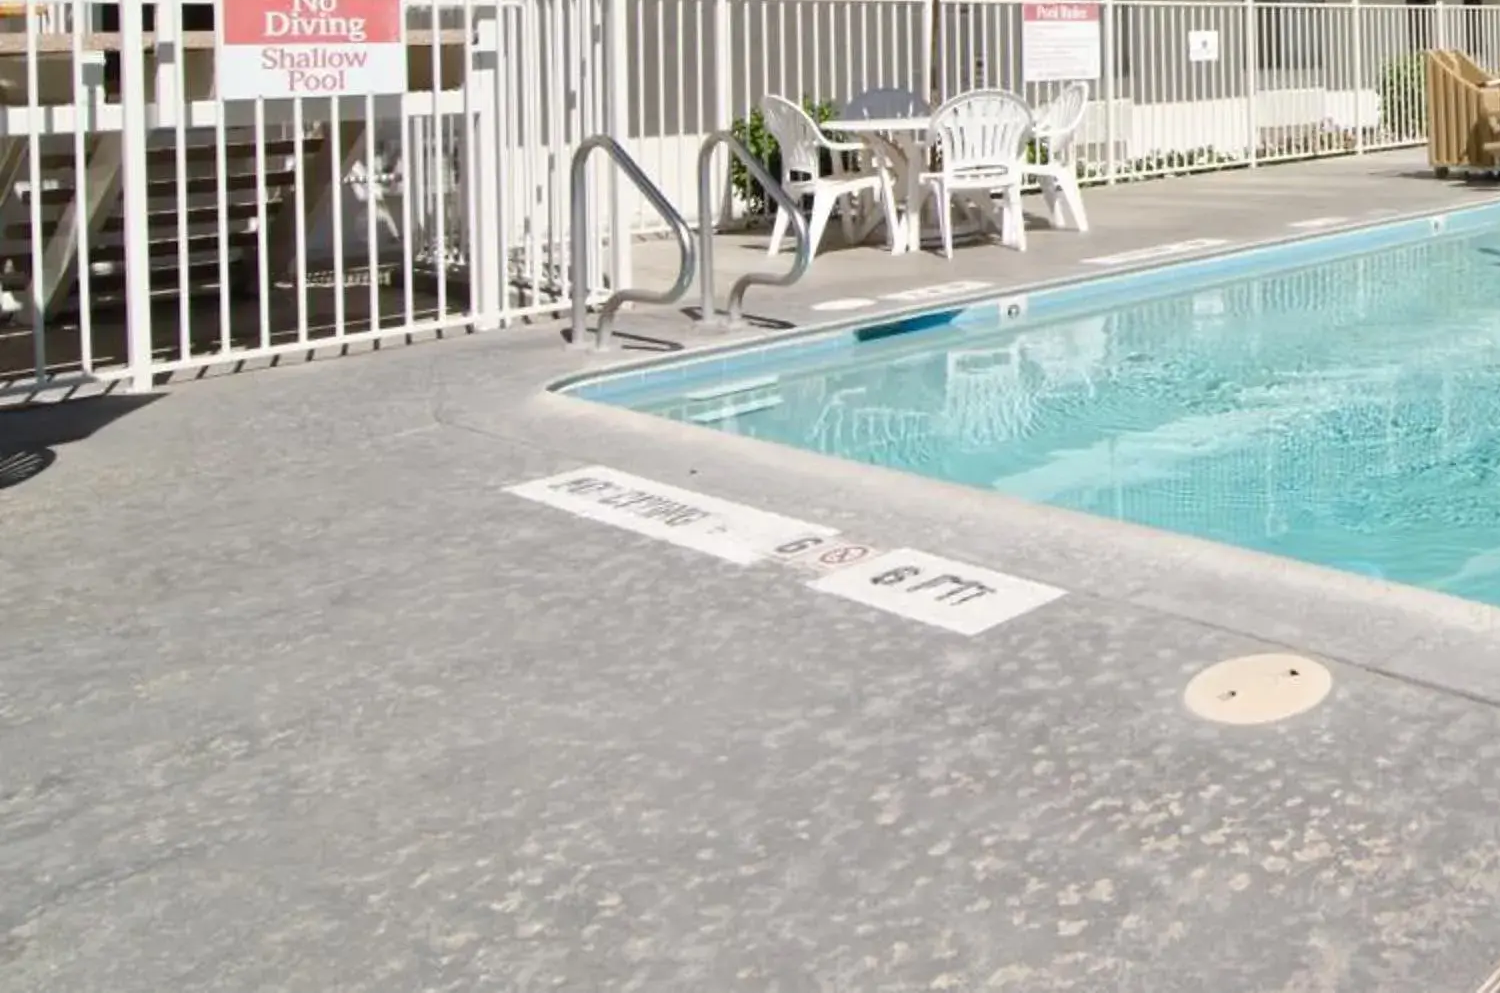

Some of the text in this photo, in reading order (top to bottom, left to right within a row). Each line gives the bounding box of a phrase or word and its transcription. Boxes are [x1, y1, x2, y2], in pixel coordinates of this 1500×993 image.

[263, 11, 368, 42] Diving
[261, 46, 368, 70] Shallow
[288, 69, 345, 92] Pool
[870, 565, 921, 586] 6
